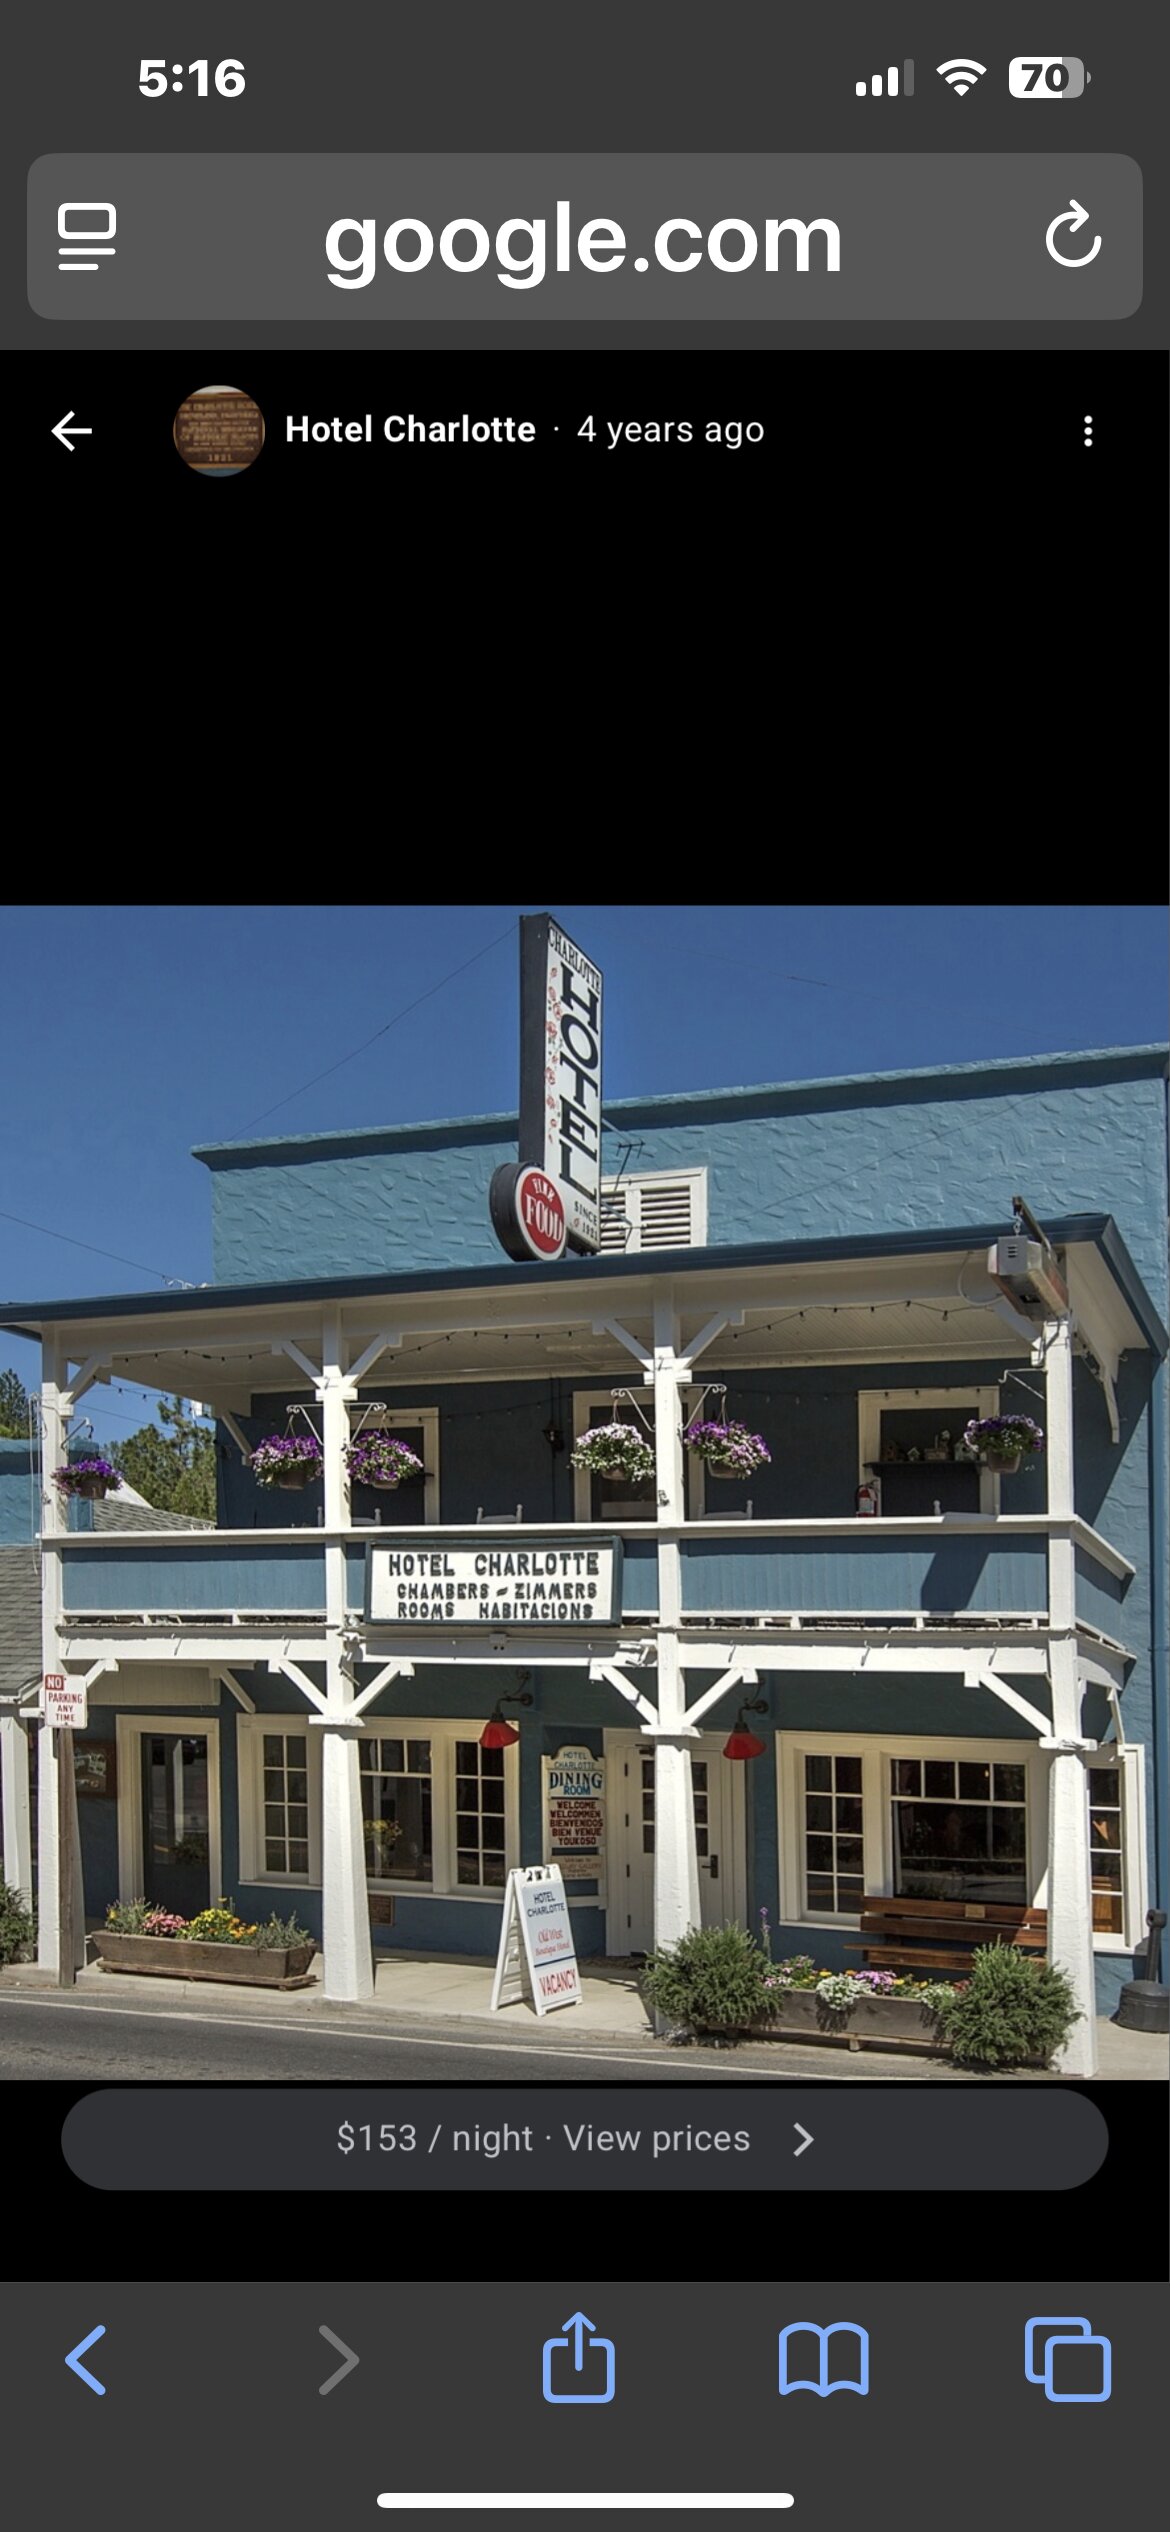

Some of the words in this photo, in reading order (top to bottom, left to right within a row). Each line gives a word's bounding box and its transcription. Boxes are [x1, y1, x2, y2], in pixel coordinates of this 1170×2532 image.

[138, 59, 246, 98] 5:16
[1021, 63, 1069, 92] 70
[325, 201, 841, 290] google.com
[286, 413, 371, 443] Hotel
[383, 413, 536, 443] Charlotte
[577, 414, 597, 443] 4
[606, 421, 694, 450] years
[705, 421, 765, 450] ago
[548, 926, 601, 997] CHARLOTTE
[560, 961, 599, 1205] HOTEL
[526, 1193, 563, 1242] FOOD
[574, 1200, 598, 1226] SINCE
[389, 1553, 456, 1577] HOTEL
[475, 1552, 600, 1576] CHARLOTTE
[397, 1583, 490, 1600] CHAMBERS
[515, 1582, 598, 1600] ZIMMERS
[398, 1601, 455, 1620] ROOMS
[479, 1601, 594, 1619] HABITACIONS
[47, 1676, 62, 1689] NO
[48, 1692, 82, 1704] PARKING
[56, 1713, 75, 1722] TIME
[57, 1704, 73, 1713] ANY
[563, 1751, 588, 1760] HOTEL
[554, 1761, 595, 1770] CHARLOTTE
[550, 1771, 603, 1790] DINING
[563, 1785, 591, 1795] ROOM
[557, 1801, 596, 1810] WELCOME
[552, 1828, 572, 1837] BIEN
[575, 1828, 602, 1837] VENUE
[534, 1892, 555, 1904] HOTEL
[527, 1903, 566, 1917] CHARLOTTE
[539, 1969, 577, 1996] VACANCY
[337, 2120, 417, 2155] $153
[453, 2122, 534, 2159] night
[563, 2124, 642, 2152] View
[653, 2123, 750, 2159] prices
